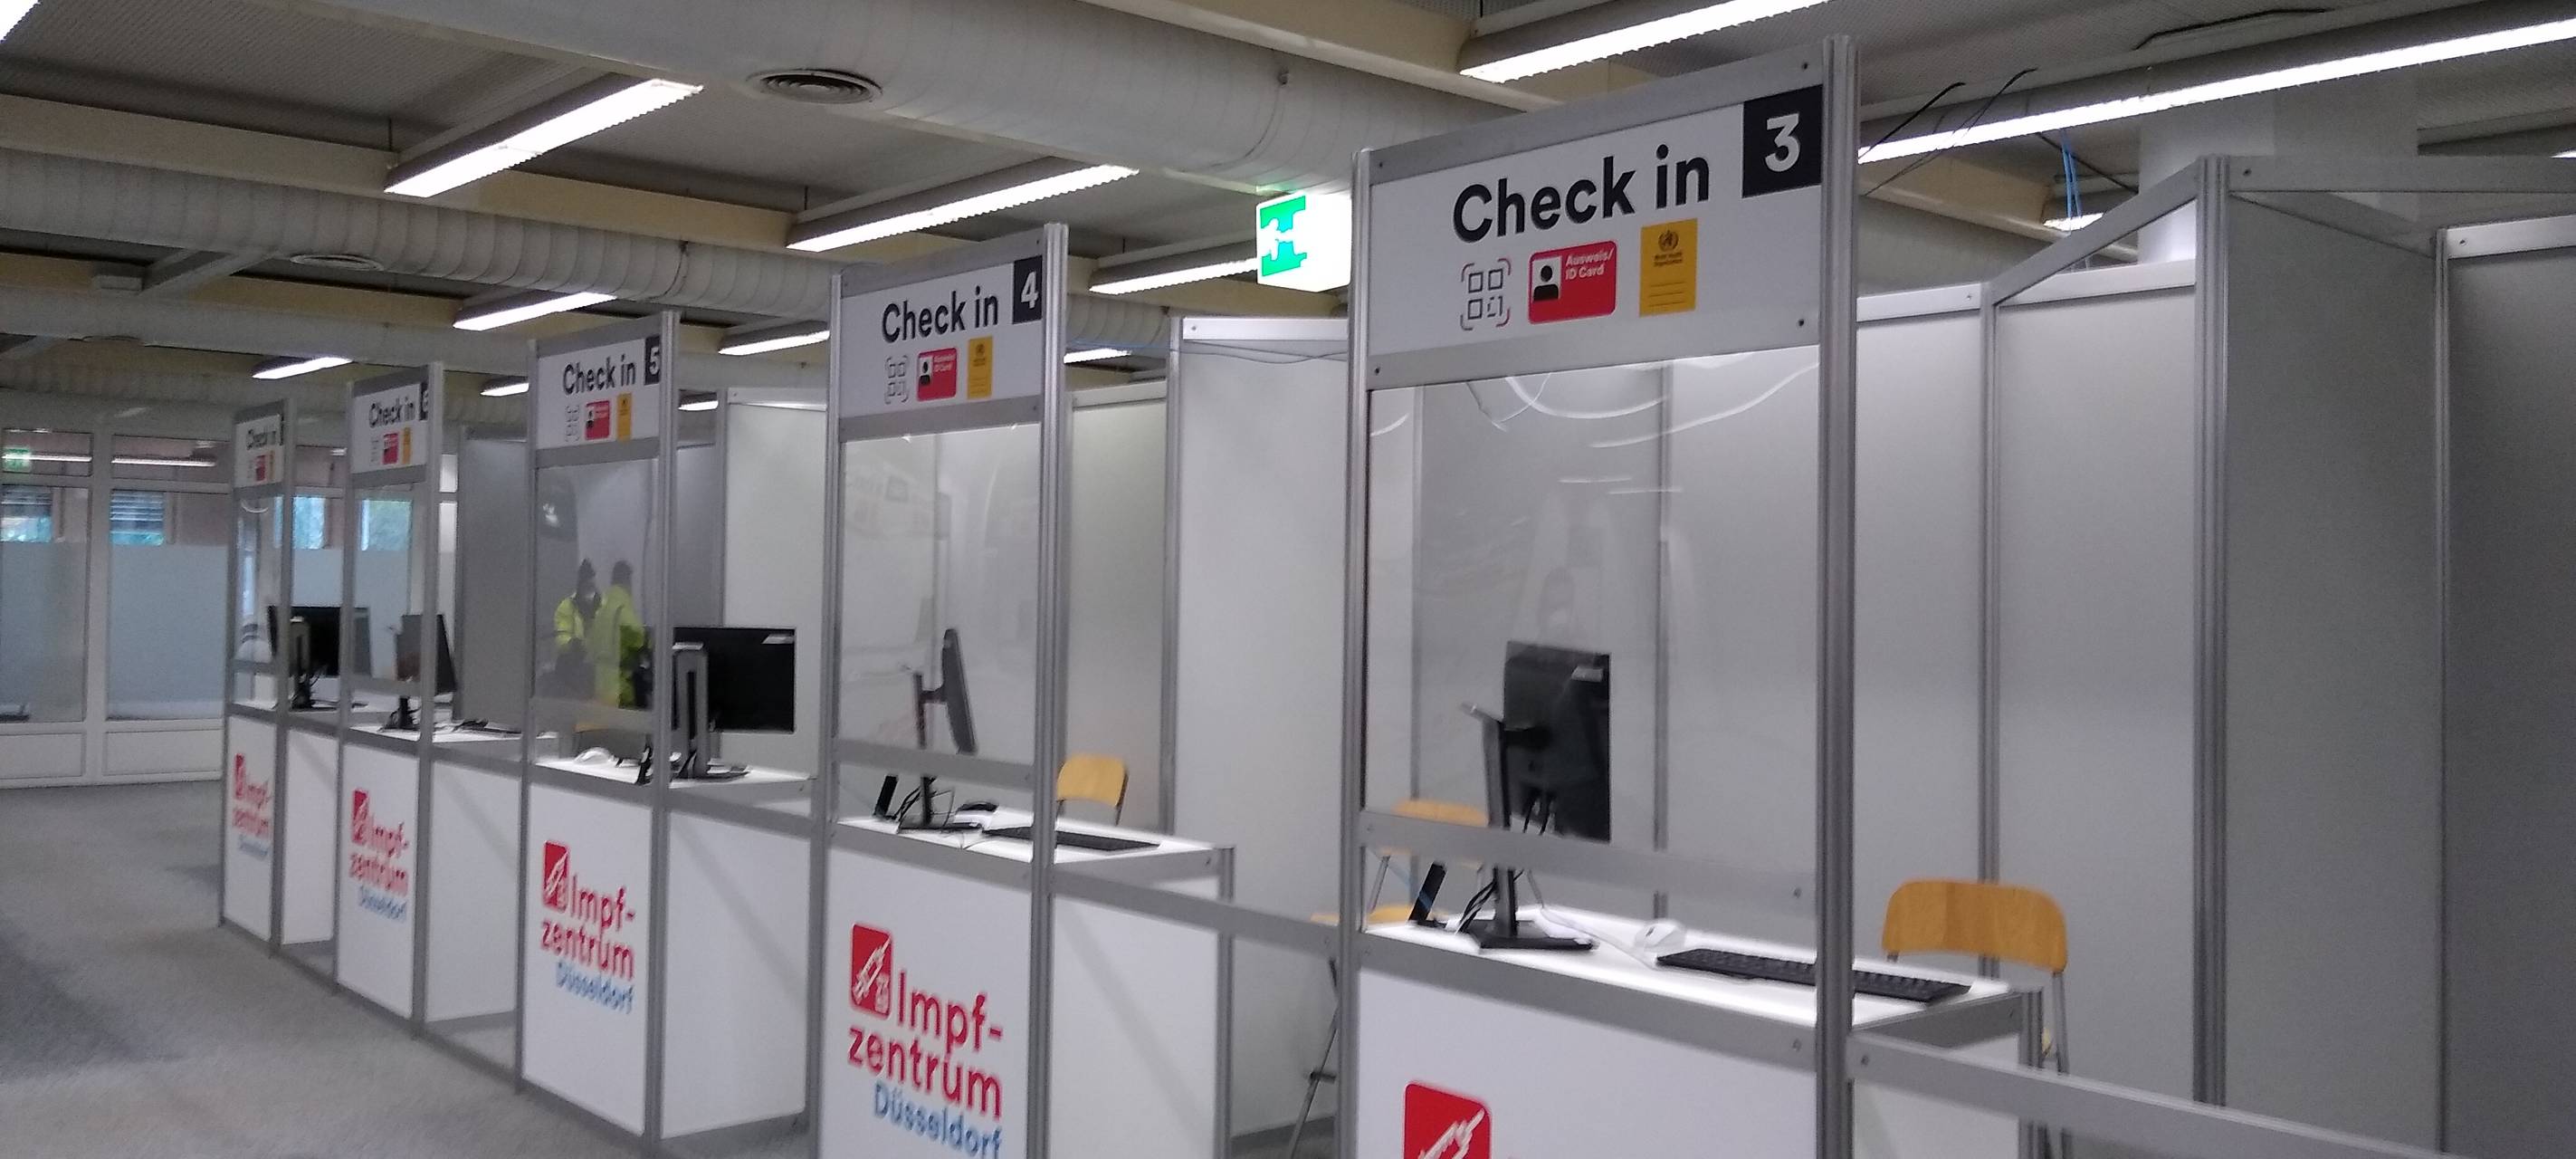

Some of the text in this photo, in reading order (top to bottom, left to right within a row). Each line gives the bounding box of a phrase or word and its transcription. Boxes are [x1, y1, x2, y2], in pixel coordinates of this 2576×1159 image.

[1453, 112, 1801, 243] Check in 3
[1565, 262, 1605, 281] ID Card
[882, 272, 1039, 343] Check in 4
[563, 346, 661, 395] Check in 5
[369, 398, 403, 428] Check
[570, 875, 635, 934] Impf-
[540, 920, 634, 982] zentrum
[897, 968, 1003, 1054] Impf-
[847, 1025, 1002, 1121] zentrum
[873, 1081, 1002, 1159] Düsseldorf
